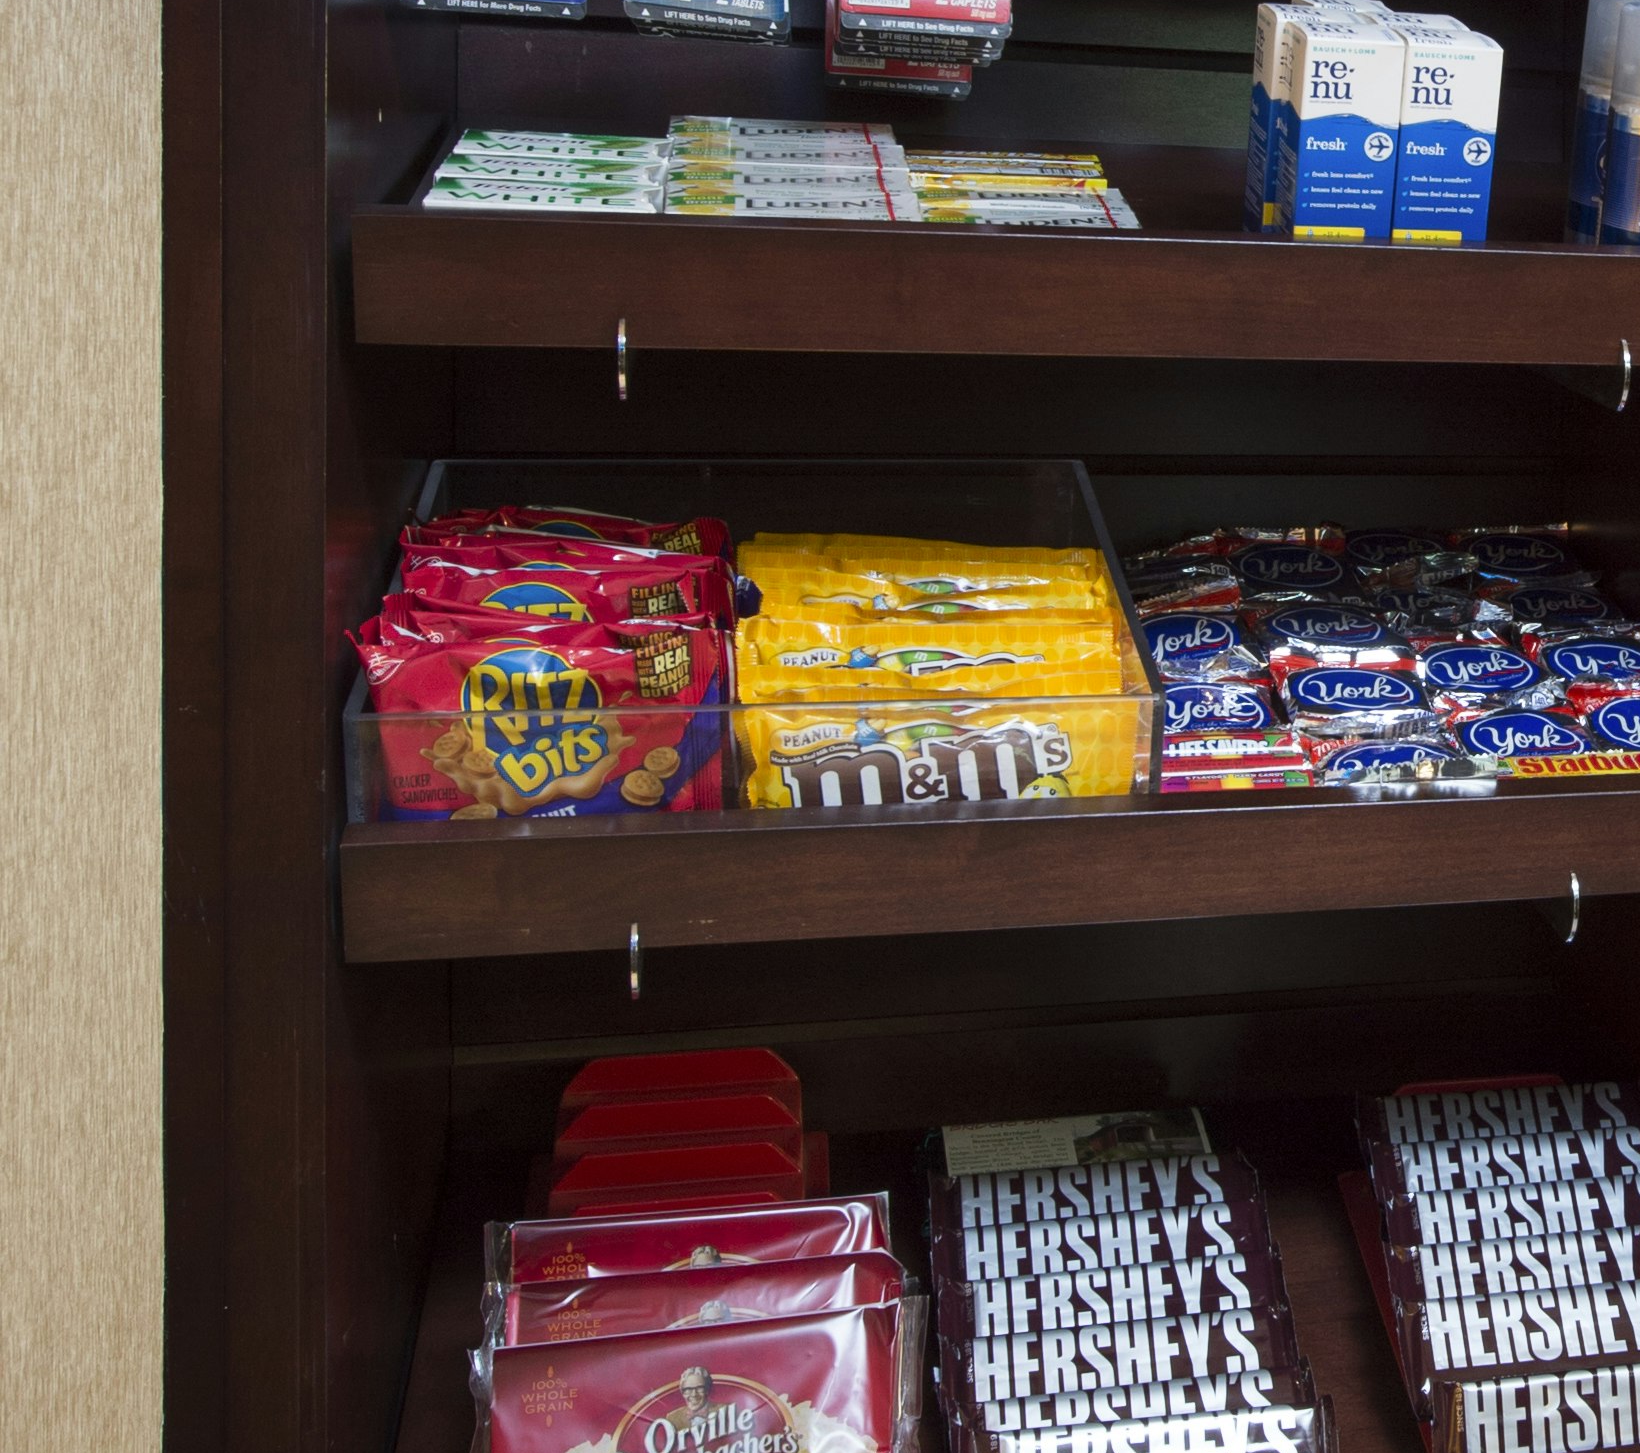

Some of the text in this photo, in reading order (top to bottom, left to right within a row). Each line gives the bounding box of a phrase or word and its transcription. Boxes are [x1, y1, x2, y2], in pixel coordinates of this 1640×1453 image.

[1313, 46, 1346, 54] BAUSCH
[1312, 60, 1347, 79] re
[1412, 65, 1448, 85] re
[1310, 80, 1353, 100] nu
[1410, 85, 1453, 106] nu
[1306, 137, 1346, 151] fresh
[1406, 142, 1446, 156] fresh
[1282, 616, 1365, 636] York
[653, 652, 690, 674] REAL
[1441, 653, 1524, 680] York
[1308, 670, 1396, 700] York
[470, 665, 594, 756] RITZ
[1168, 692, 1253, 729] York
[783, 726, 842, 748] PEANUT
[1482, 726, 1563, 756] York
[500, 726, 602, 794] bits
[964, 1203, 1236, 1281] HERSHEY'S
[973, 1253, 1252, 1337] HERSHEY'S
[973, 1309, 1260, 1402] HERSHEY'S
[531, 1379, 569, 1390] 100%
[522, 1388, 579, 1403] WHOLE
[524, 1401, 574, 1415] GRAIN
